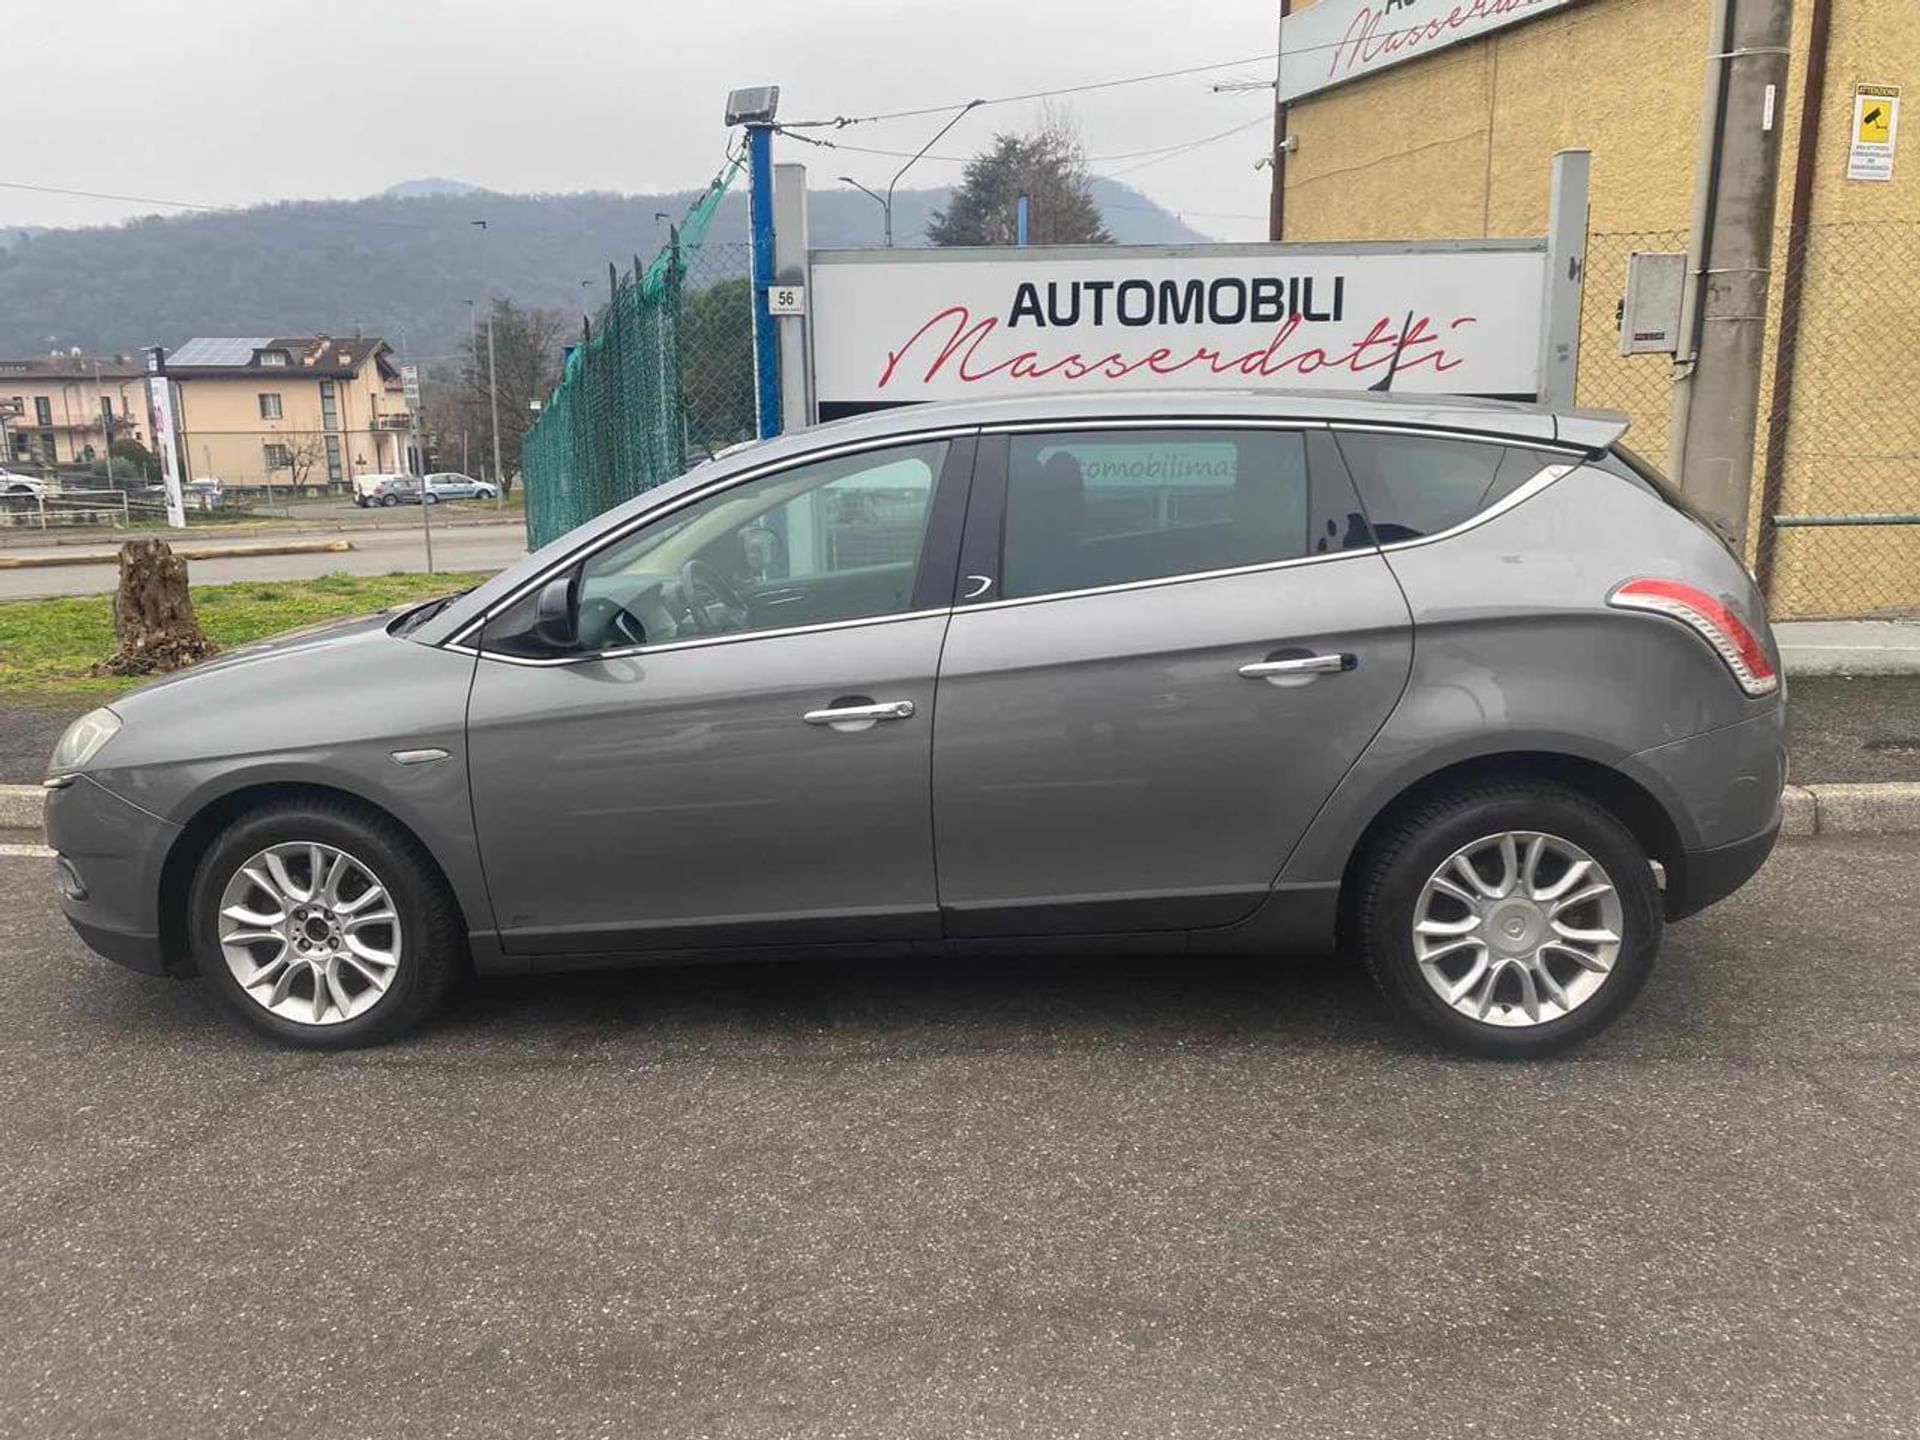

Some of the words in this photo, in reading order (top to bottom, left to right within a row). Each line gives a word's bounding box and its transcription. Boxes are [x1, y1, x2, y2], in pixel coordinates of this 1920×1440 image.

[778, 291, 794, 306] 56
[1008, 276, 1344, 328] AUTOMOBILI
[878, 306, 1477, 388] Masserdotti
